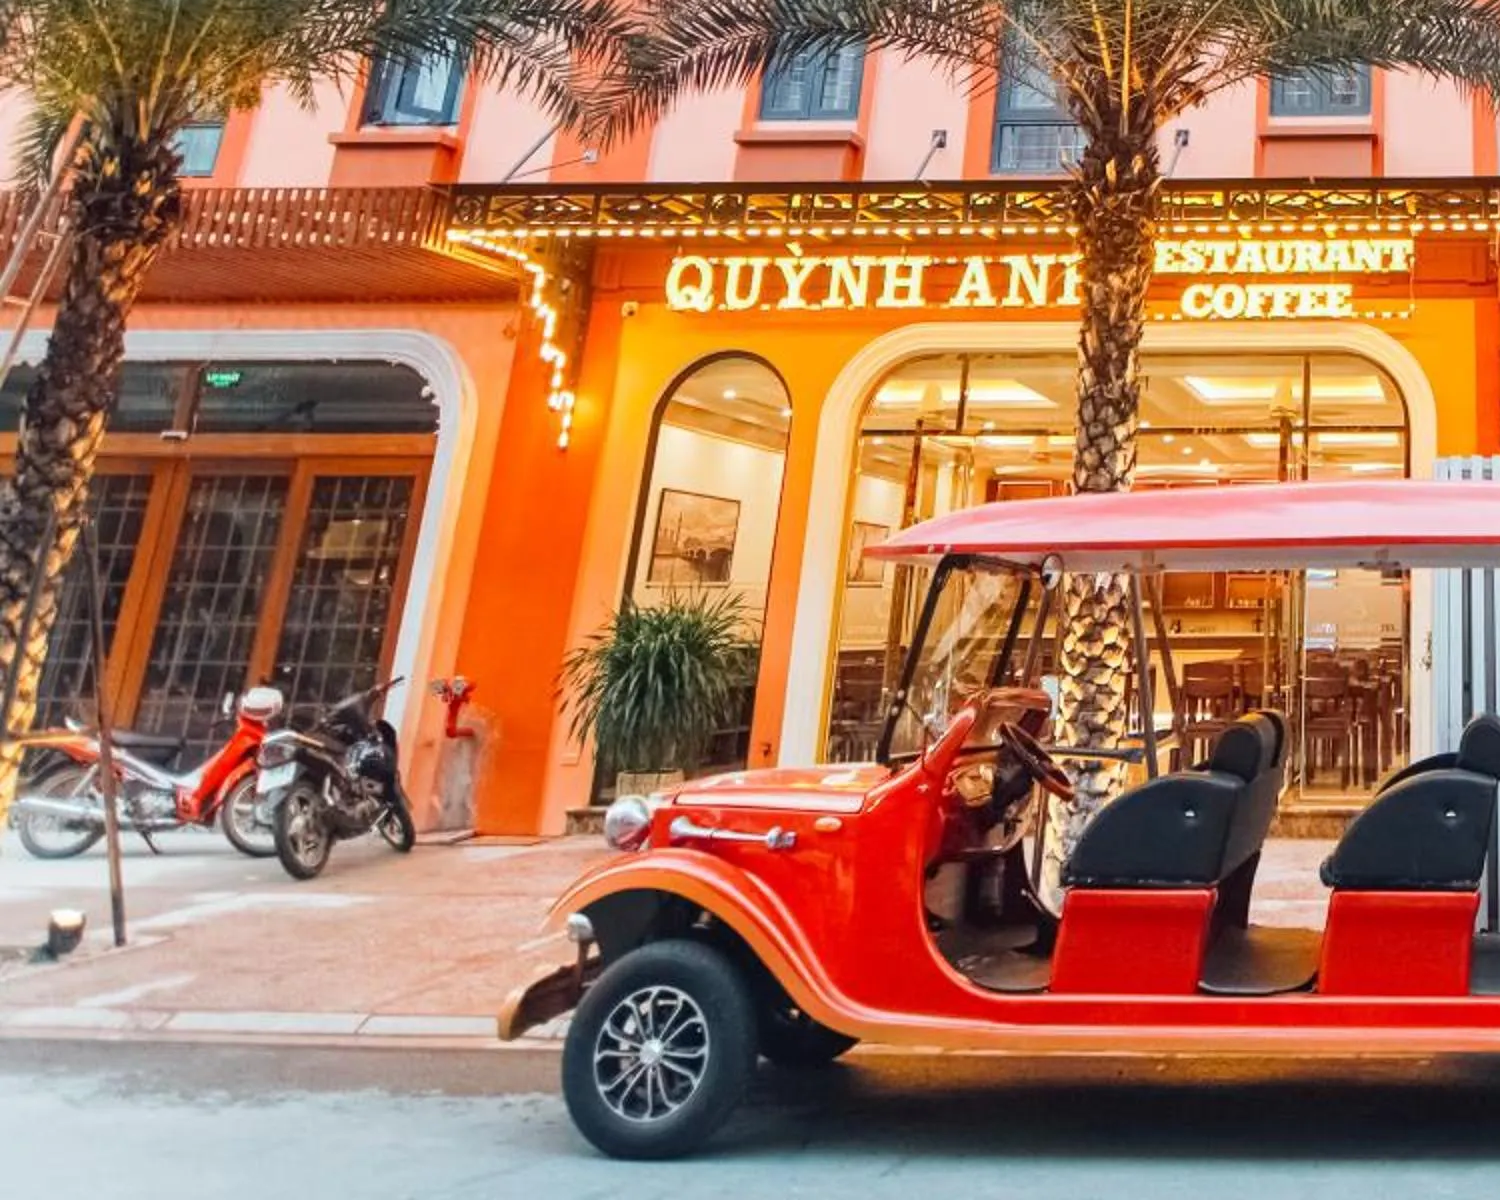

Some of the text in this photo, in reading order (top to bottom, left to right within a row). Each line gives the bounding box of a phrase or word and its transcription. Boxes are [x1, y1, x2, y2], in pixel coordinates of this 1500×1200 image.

[1153, 238, 1414, 274] ESTAURANT
[665, 242, 932, 312] QUỲNH
[1180, 283, 1354, 318] COFFEE
